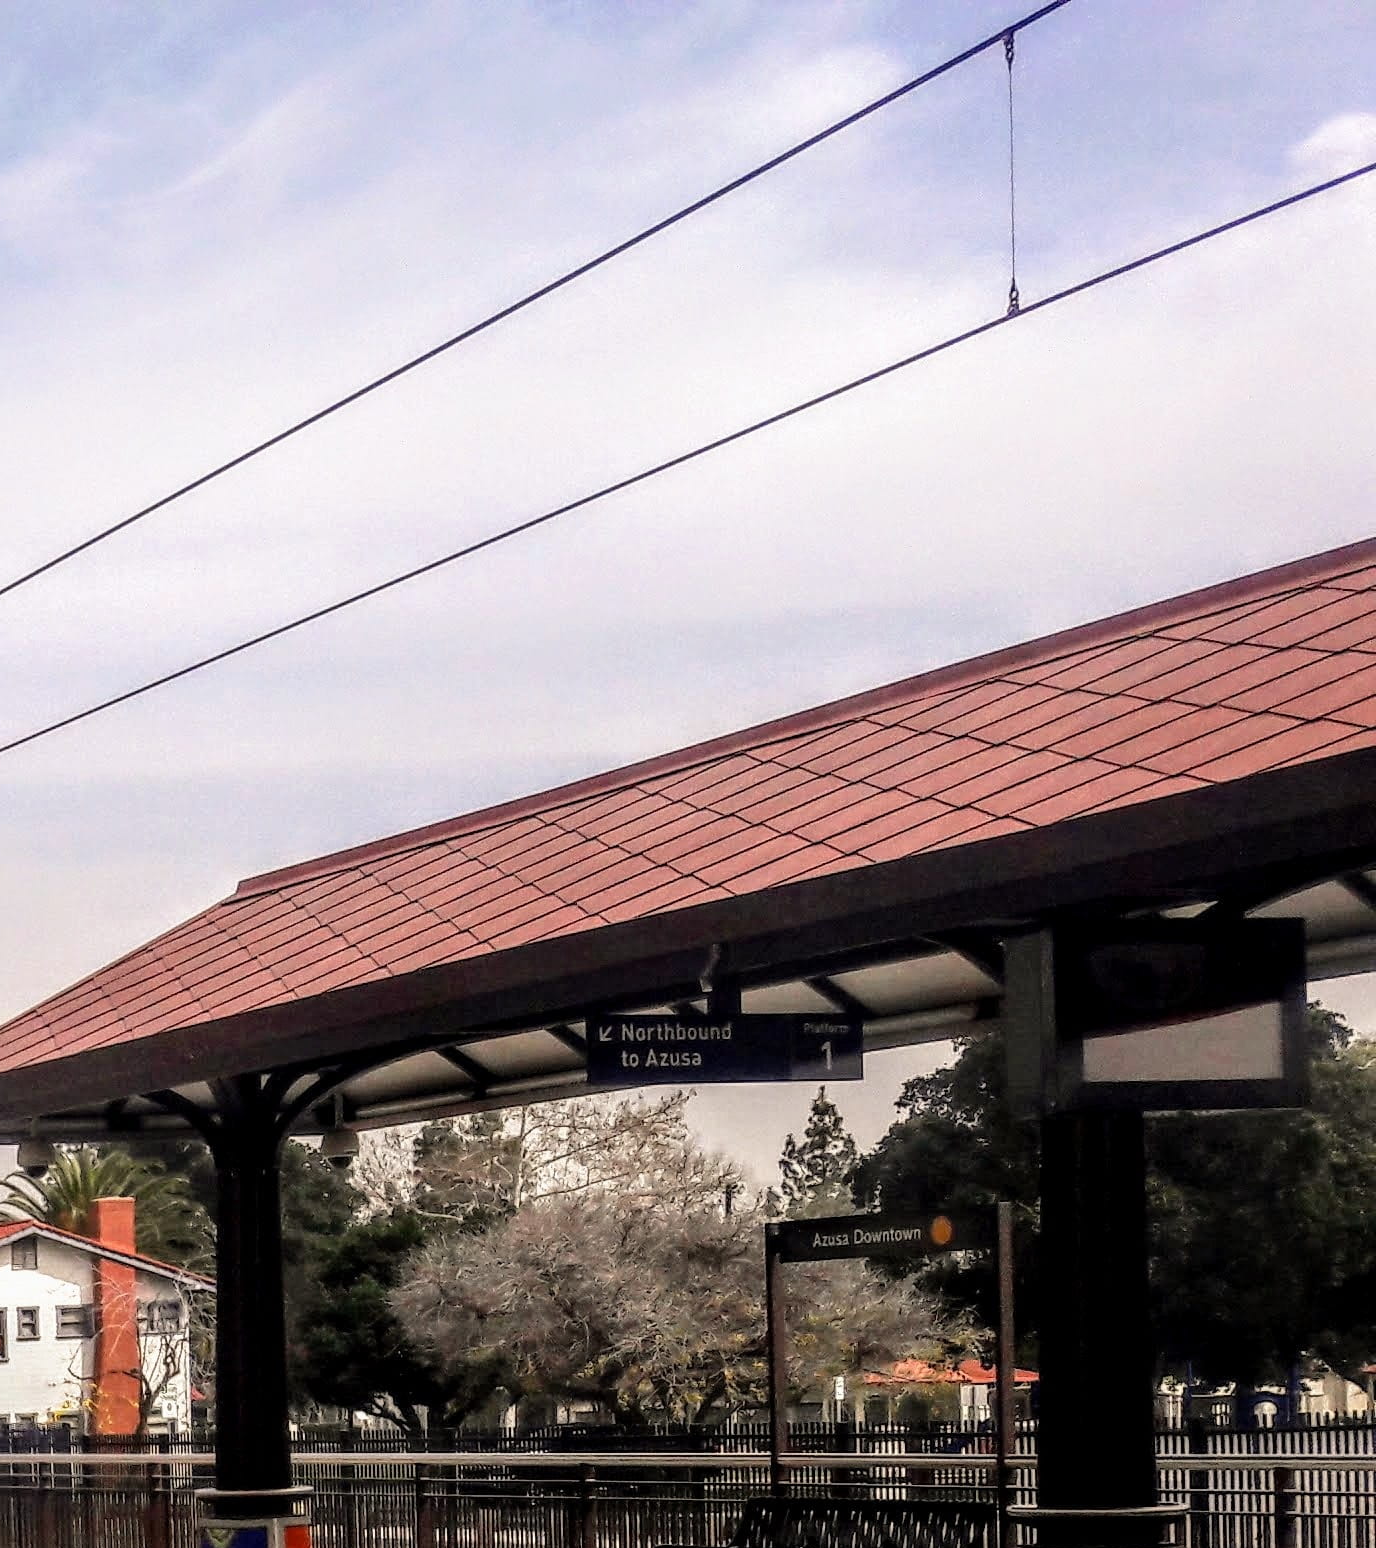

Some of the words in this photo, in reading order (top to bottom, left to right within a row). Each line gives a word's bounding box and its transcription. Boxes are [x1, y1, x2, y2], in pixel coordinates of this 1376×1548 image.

[622, 1022, 733, 1042] Northbound
[803, 1022, 850, 1034] Platform
[622, 1050, 639, 1067] to
[645, 1048, 702, 1067] Azusa
[821, 1041, 833, 1071] 1
[812, 1232, 850, 1248] Azusa
[854, 1227, 922, 1245] Downtown
